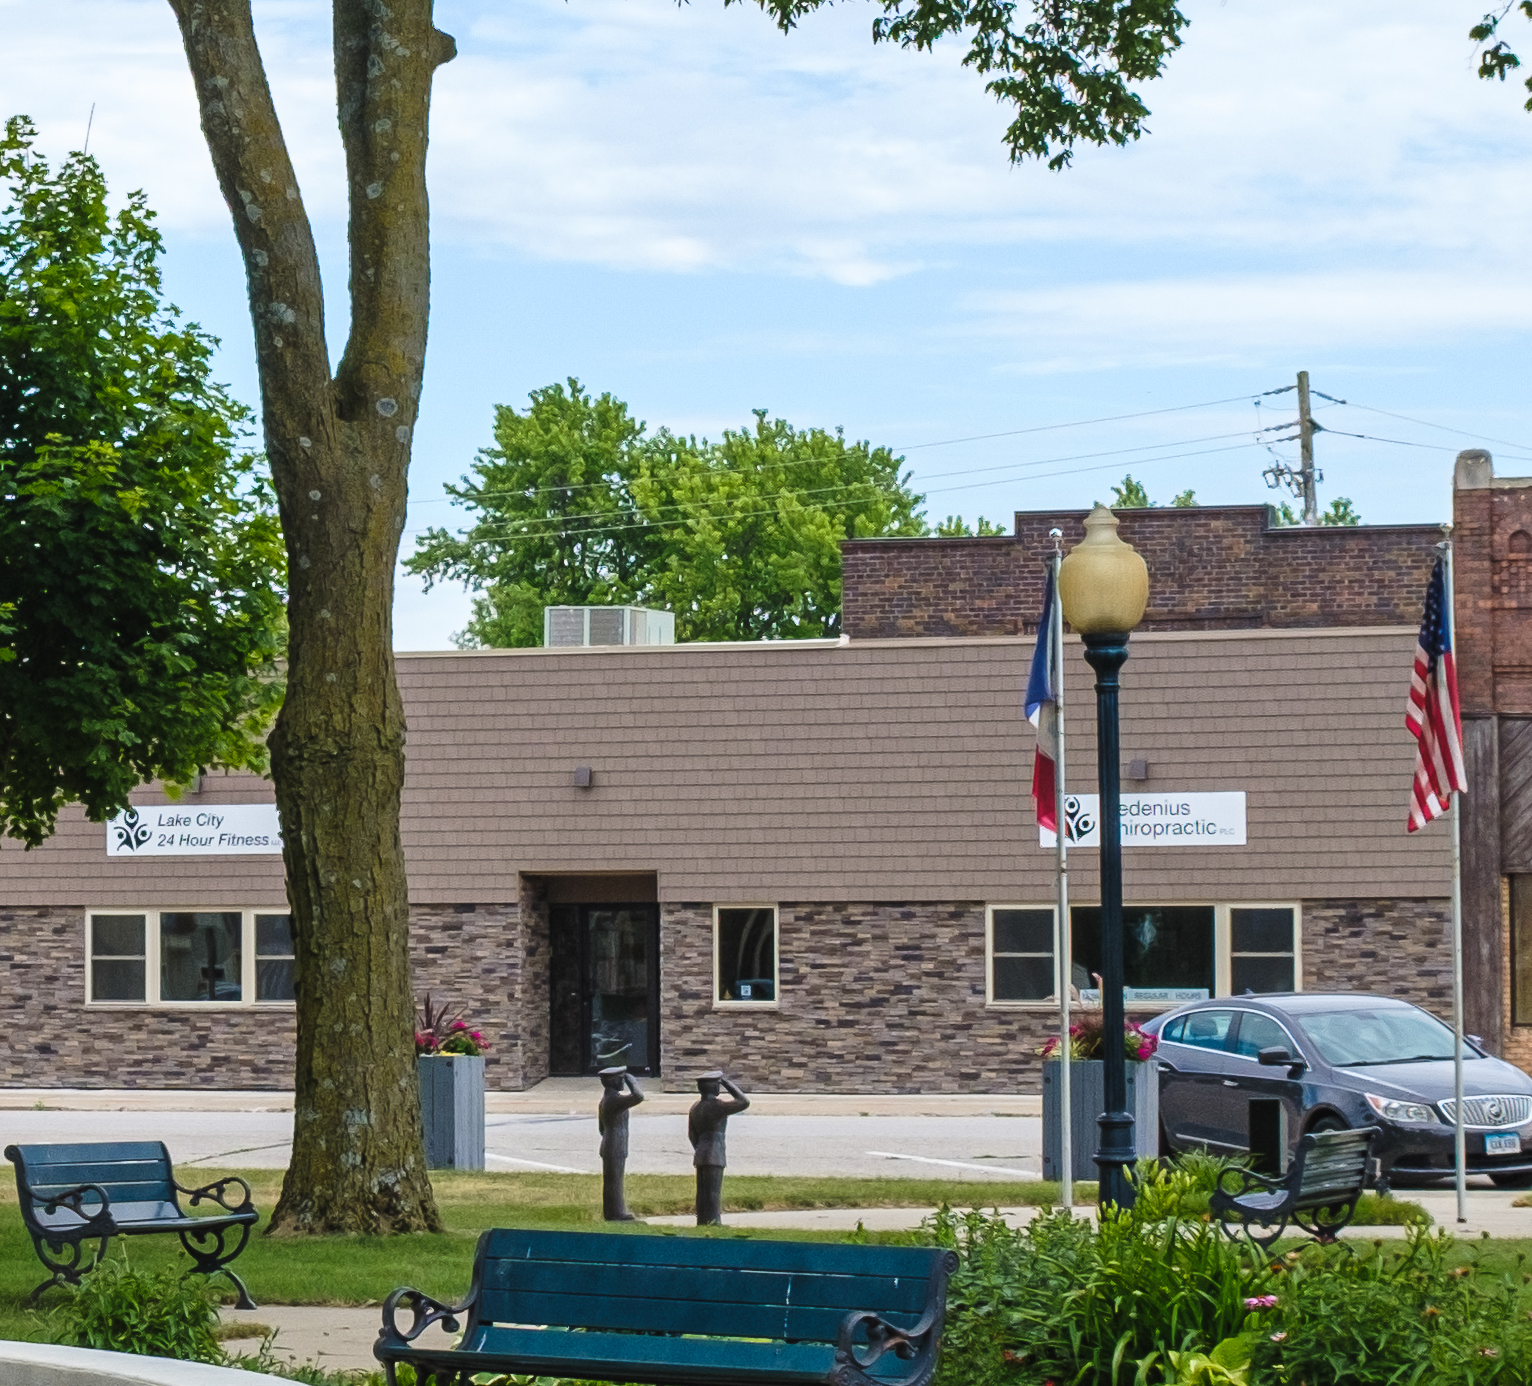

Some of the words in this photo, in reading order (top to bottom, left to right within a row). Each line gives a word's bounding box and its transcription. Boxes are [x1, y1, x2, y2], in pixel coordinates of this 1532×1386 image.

[1119, 800, 1191, 816] edenius
[157, 813, 191, 827] Lake
[196, 813, 225, 828] City
[1121, 819, 1217, 839] hiropractic
[157, 834, 174, 846] 24
[179, 833, 214, 846] Hour
[218, 833, 269, 846] Fitness
